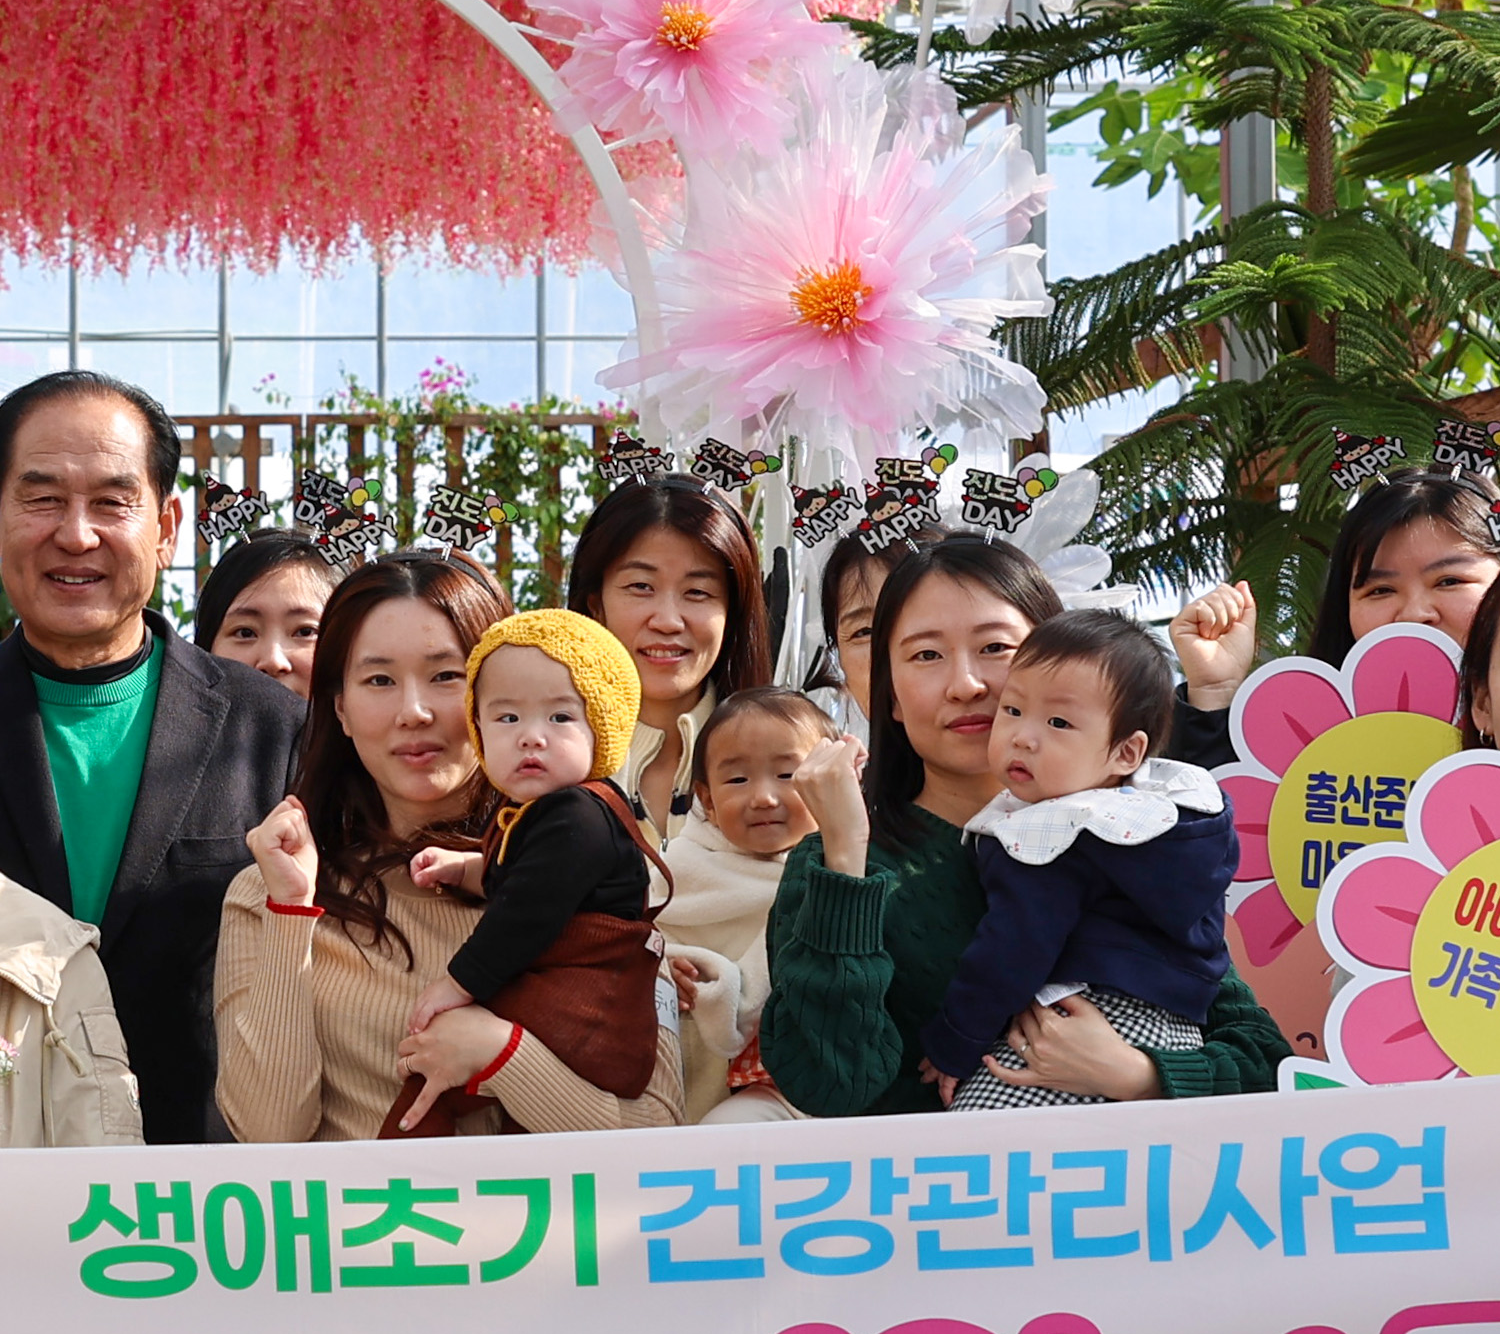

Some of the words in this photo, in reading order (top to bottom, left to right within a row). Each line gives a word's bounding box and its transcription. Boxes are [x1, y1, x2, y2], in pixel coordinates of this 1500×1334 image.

[1437, 419, 1486, 449] 진도
[599, 454, 674, 479] HAPPY
[692, 460, 744, 491] DAY
[877, 460, 925, 484] 진도
[1331, 438, 1406, 489] HAPPY
[1435, 444, 1492, 472] DAY
[963, 470, 1018, 503] 진도
[199, 492, 269, 543] HAPPY
[295, 499, 326, 530] DA
[431, 486, 485, 524] 진도
[795, 488, 862, 547] HAPPY
[964, 501, 1025, 532] DAY
[318, 516, 397, 564] HAPPY
[424, 516, 484, 550] DAY
[860, 498, 940, 554] HAPPY
[1305, 770, 1416, 829] 출산준
[1301, 839, 1367, 888] 마
[69, 1173, 598, 1299] 생애초기
[639, 1127, 1450, 1283] 건강관리사업
